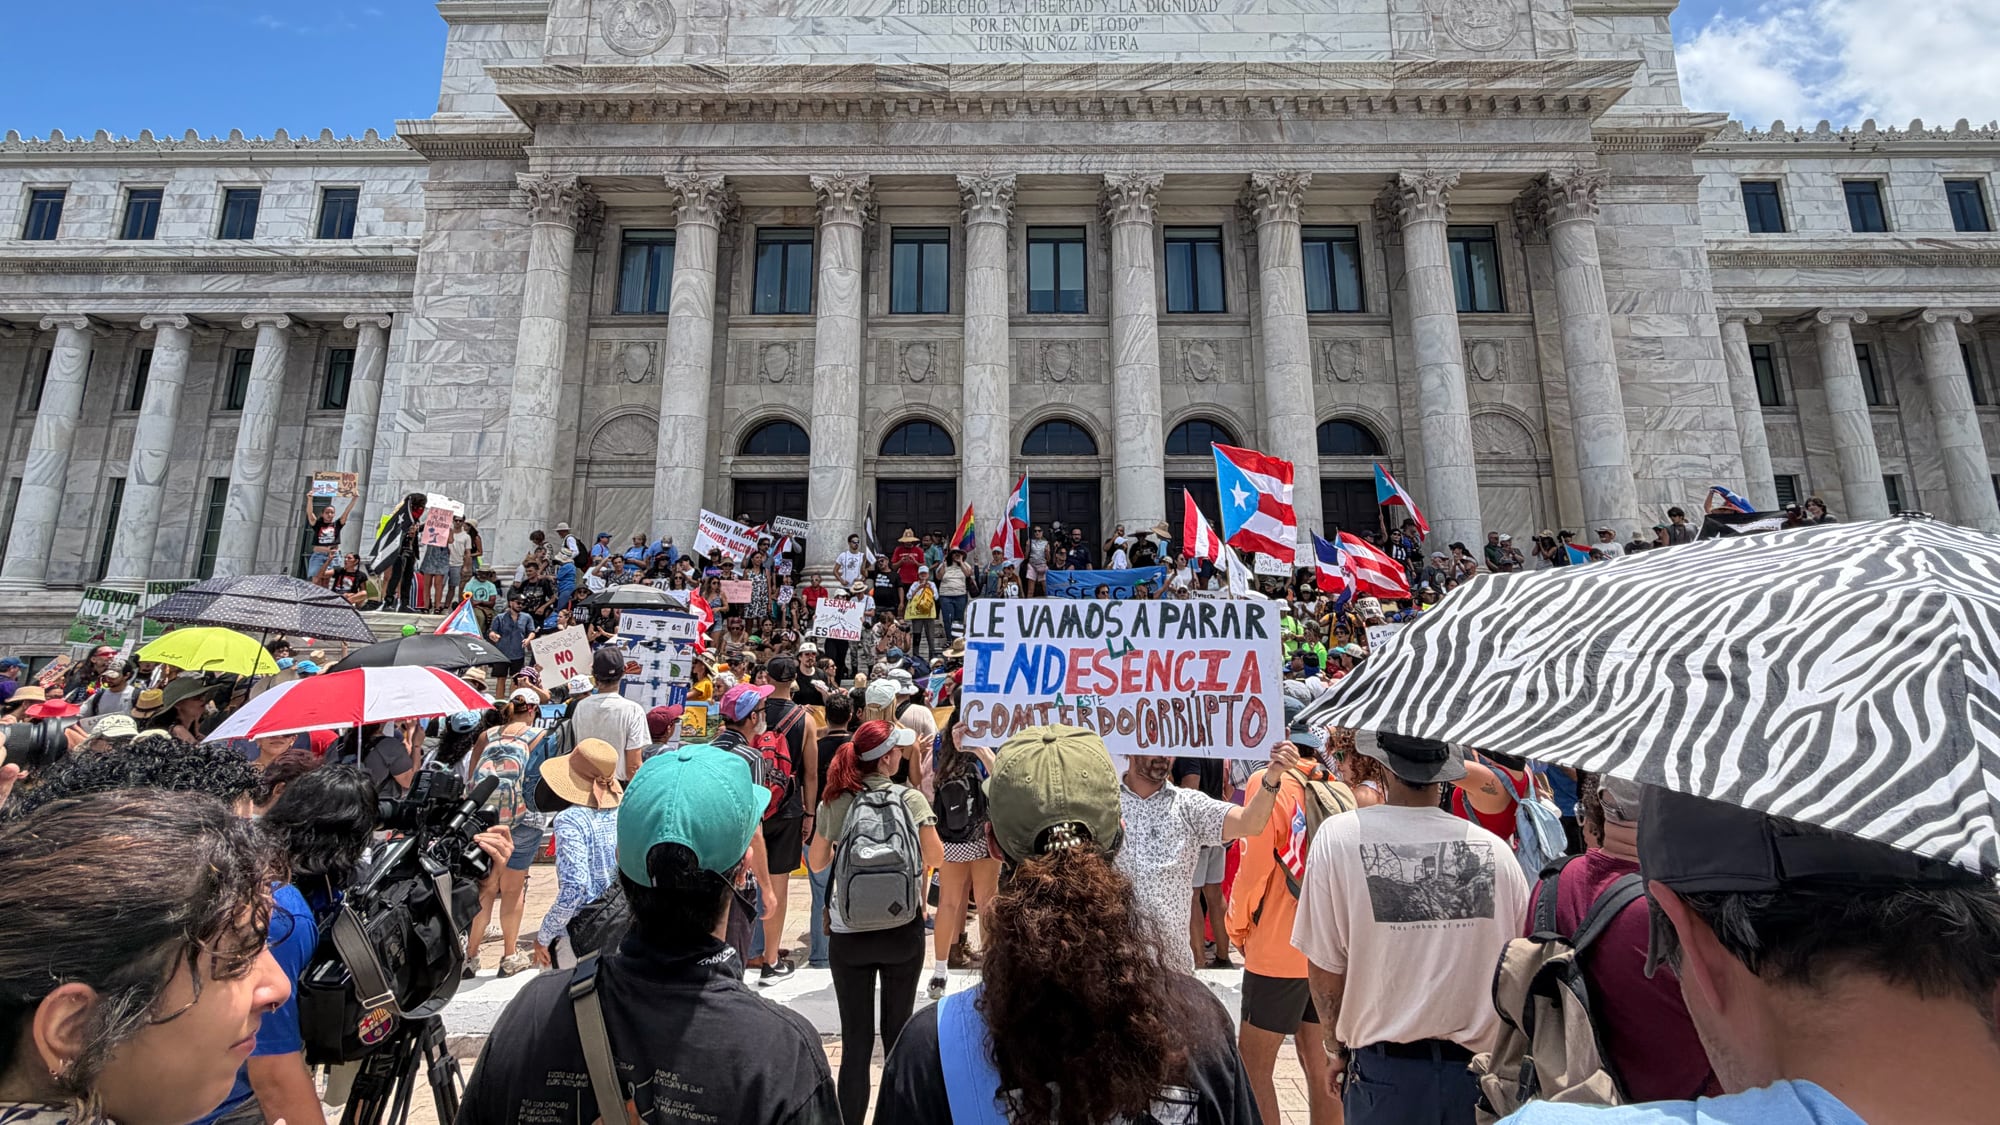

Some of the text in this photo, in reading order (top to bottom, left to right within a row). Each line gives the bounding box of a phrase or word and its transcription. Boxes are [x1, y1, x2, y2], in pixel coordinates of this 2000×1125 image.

[999, 0, 1016, 14] LA
[1024, 0, 1093, 13] LIBERTAD
[1102, 0, 1109, 12] Y
[1119, 0, 1137, 12] LA
[1146, 0, 1217, 12] DIGNIDAD
[970, 18, 997, 32] POR
[1003, 18, 1061, 32] ENCIMA
[1070, 18, 1089, 32] DE
[978, 34, 1139, 51] LUIS MUÑOZ RIVERA
[701, 513, 732, 534] Johnny
[775, 517, 810, 530] DESLINDE
[772, 526, 807, 538] NACIONAL
[80, 598, 105, 617] NO
[823, 599, 857, 610] ESENCIA
[969, 600, 1268, 640] LE VAMOS A PARAR
[814, 626, 828, 637] ES
[1106, 636, 1136, 661] LA
[554, 649, 574, 665] NO
[560, 666, 578, 680] VA
[963, 641, 1263, 697] INDESENCIA
[1076, 694, 1106, 708] ESTE
